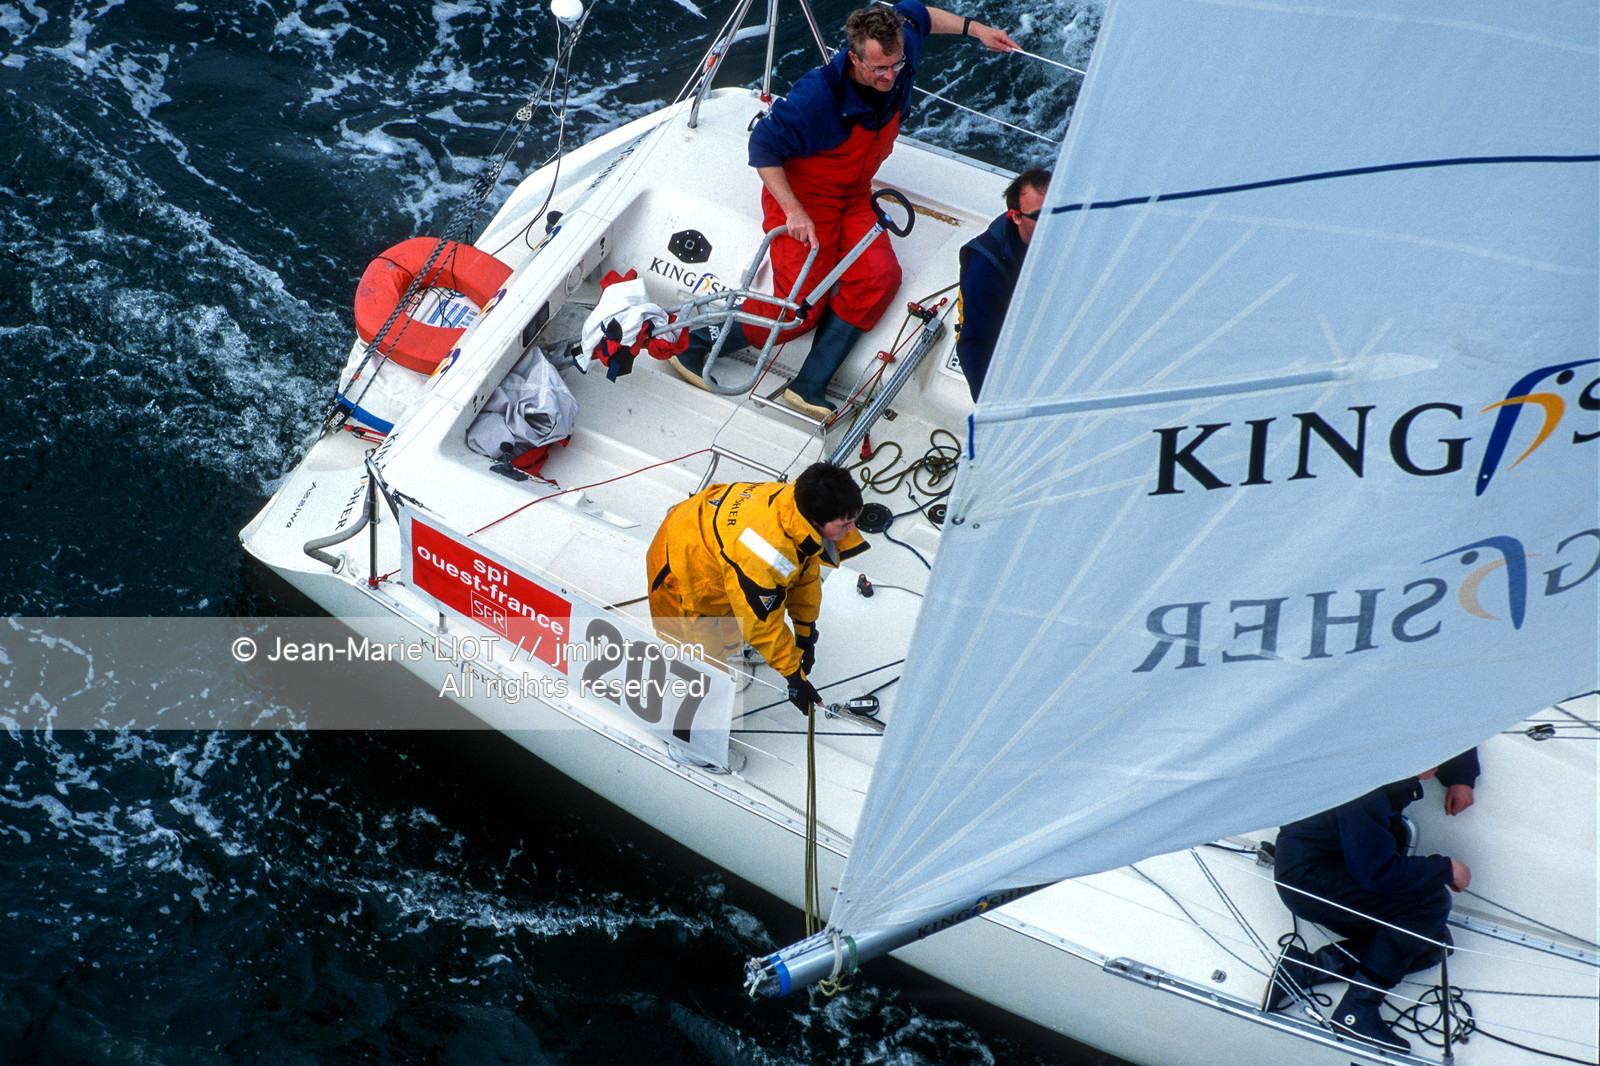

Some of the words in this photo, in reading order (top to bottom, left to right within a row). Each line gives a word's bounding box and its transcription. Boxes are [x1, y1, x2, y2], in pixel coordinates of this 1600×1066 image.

[417, 545, 564, 635] ouest-france
[473, 558, 509, 586] spi
[473, 599, 504, 629] SFR
[583, 618, 712, 744] 207
